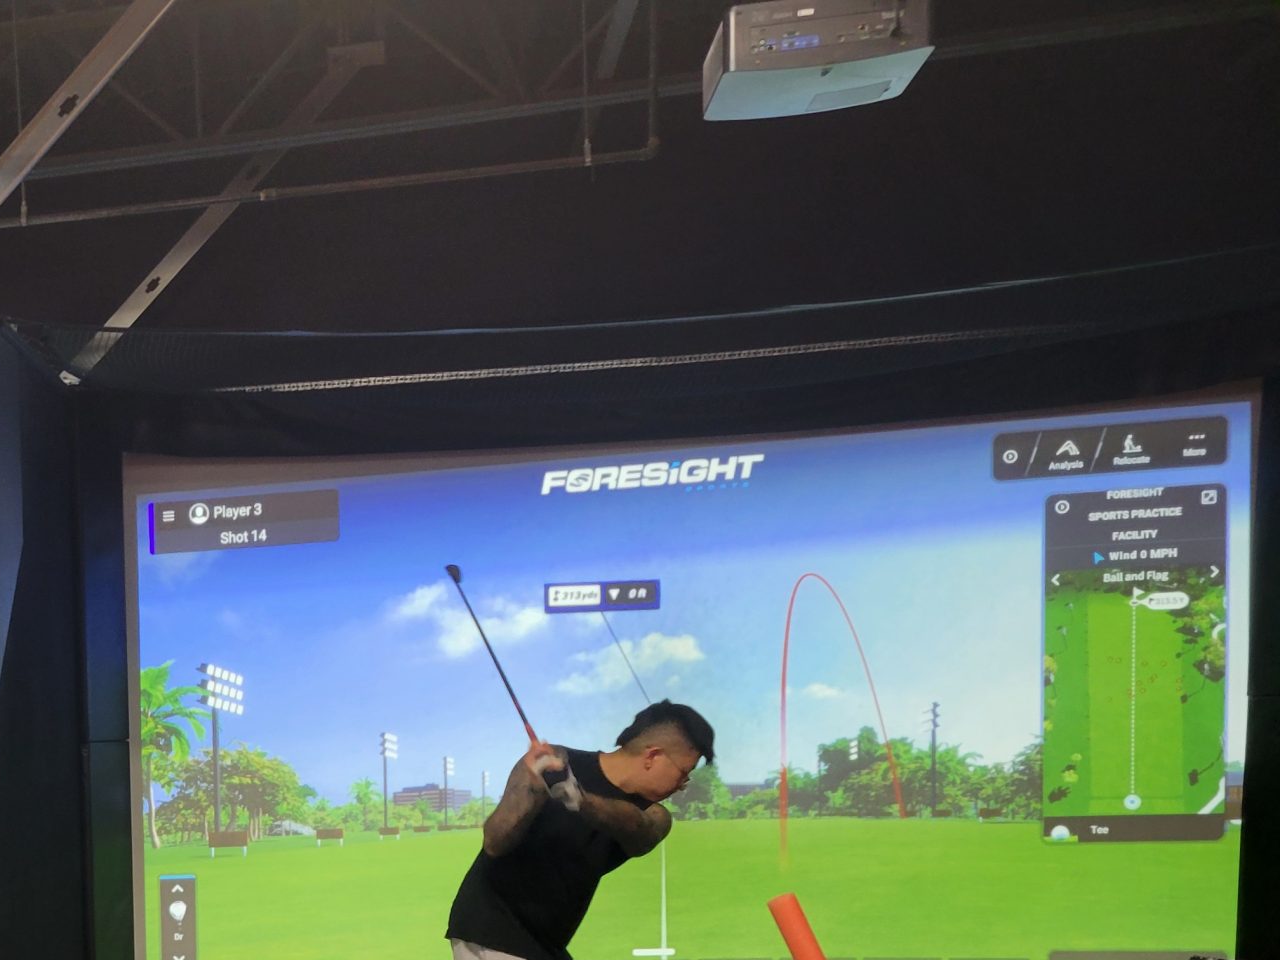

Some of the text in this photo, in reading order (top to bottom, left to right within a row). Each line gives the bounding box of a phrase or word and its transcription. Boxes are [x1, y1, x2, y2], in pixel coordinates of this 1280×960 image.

[1049, 460, 1084, 471] Analysis
[1107, 487, 1164, 500] FORESIGHT
[213, 503, 262, 520] Player 3
[1088, 506, 1183, 522] SPORTS PRACTICE
[220, 528, 267, 544] Shot 14
[1112, 529, 1158, 541] FACILITY
[1109, 548, 1178, 561] Wind 0 MPH
[1103, 570, 1169, 583] Ball and Flag
[1090, 825, 1109, 834] Tee
[174, 933, 184, 941] Dr
